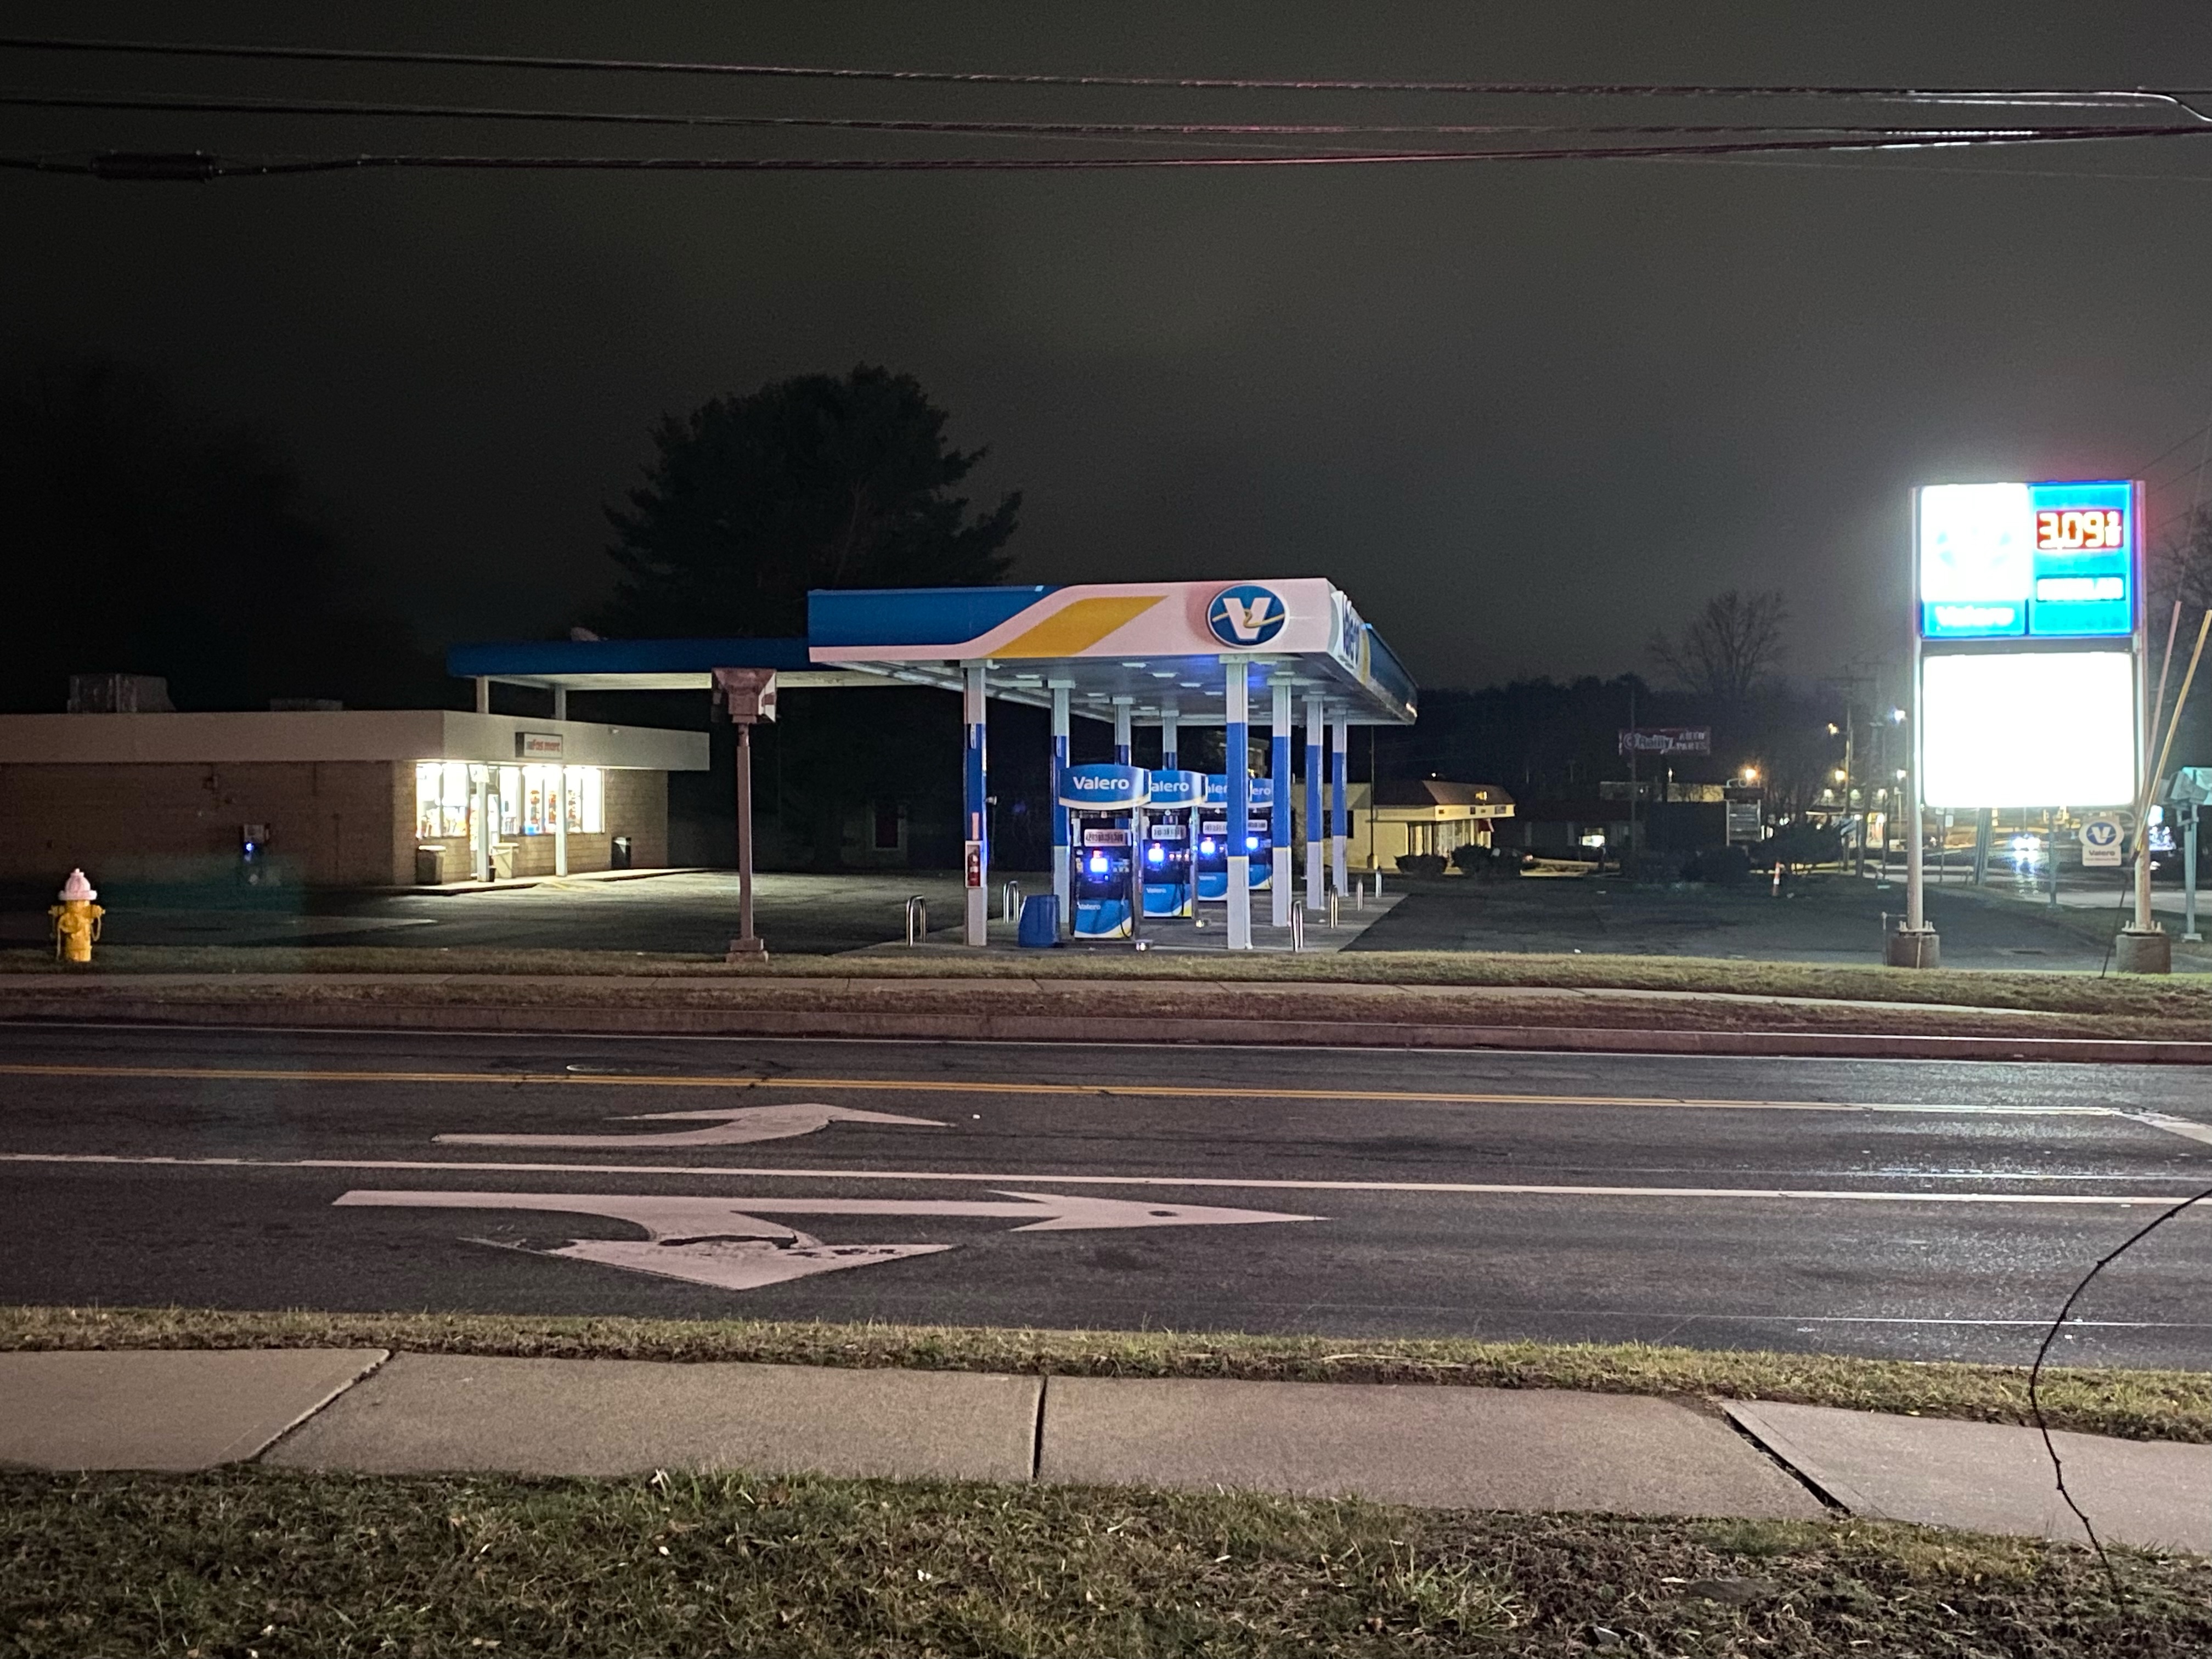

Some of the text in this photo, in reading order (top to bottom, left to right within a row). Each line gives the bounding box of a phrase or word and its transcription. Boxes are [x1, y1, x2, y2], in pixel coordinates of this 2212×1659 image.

[1223, 597, 1272, 640] V
[1073, 776, 1130, 790] Valero
[1151, 781, 1189, 792] alero
[1207, 784, 1227, 794] aler
[1252, 787, 1271, 795] ero
